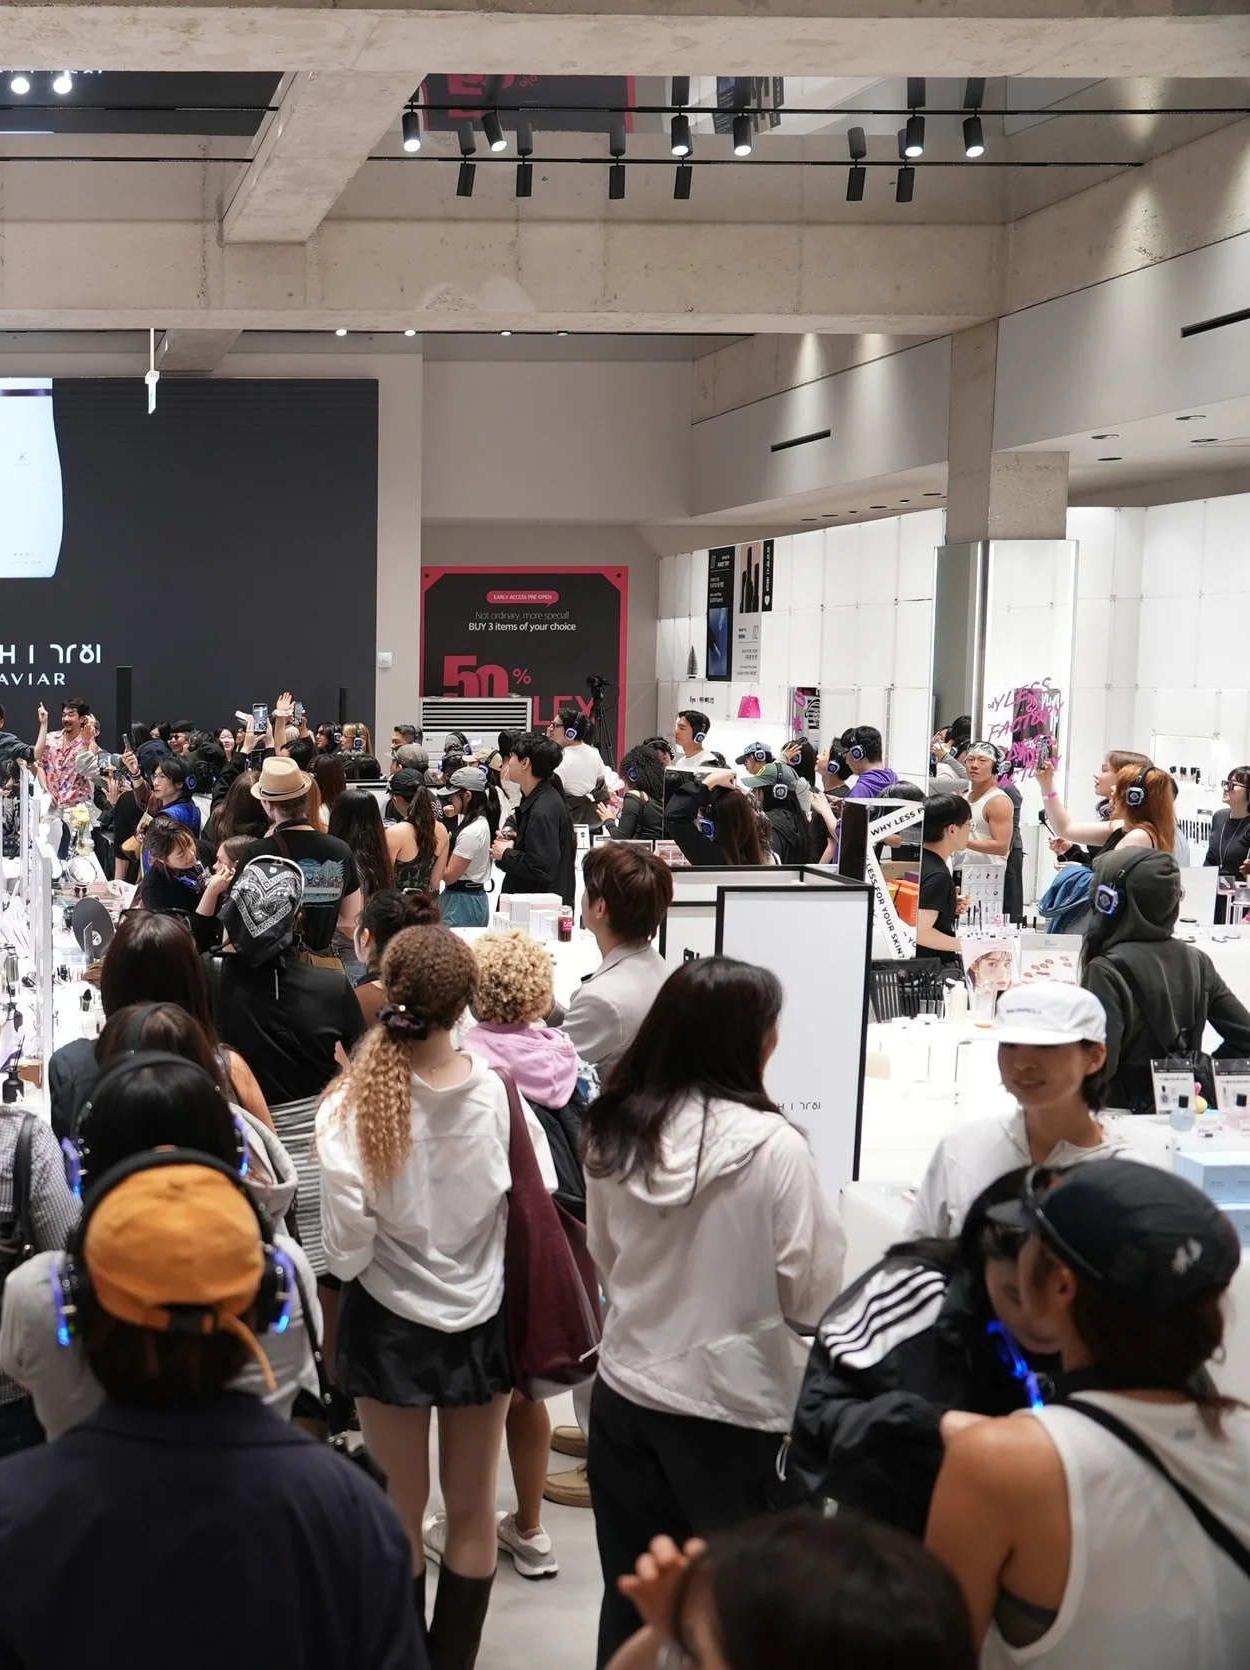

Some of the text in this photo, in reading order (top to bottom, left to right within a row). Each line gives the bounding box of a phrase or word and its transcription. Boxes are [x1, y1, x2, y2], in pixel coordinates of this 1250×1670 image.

[475, 611, 490, 620] Not
[468, 622, 577, 632] BUY 3 items of your choice
[870, 822, 892, 836] WHY
[894, 811, 916, 825] LESS
[874, 886, 886, 905] FOR
[882, 906, 895, 932] YOUR
[891, 933, 905, 959] SKIN?
